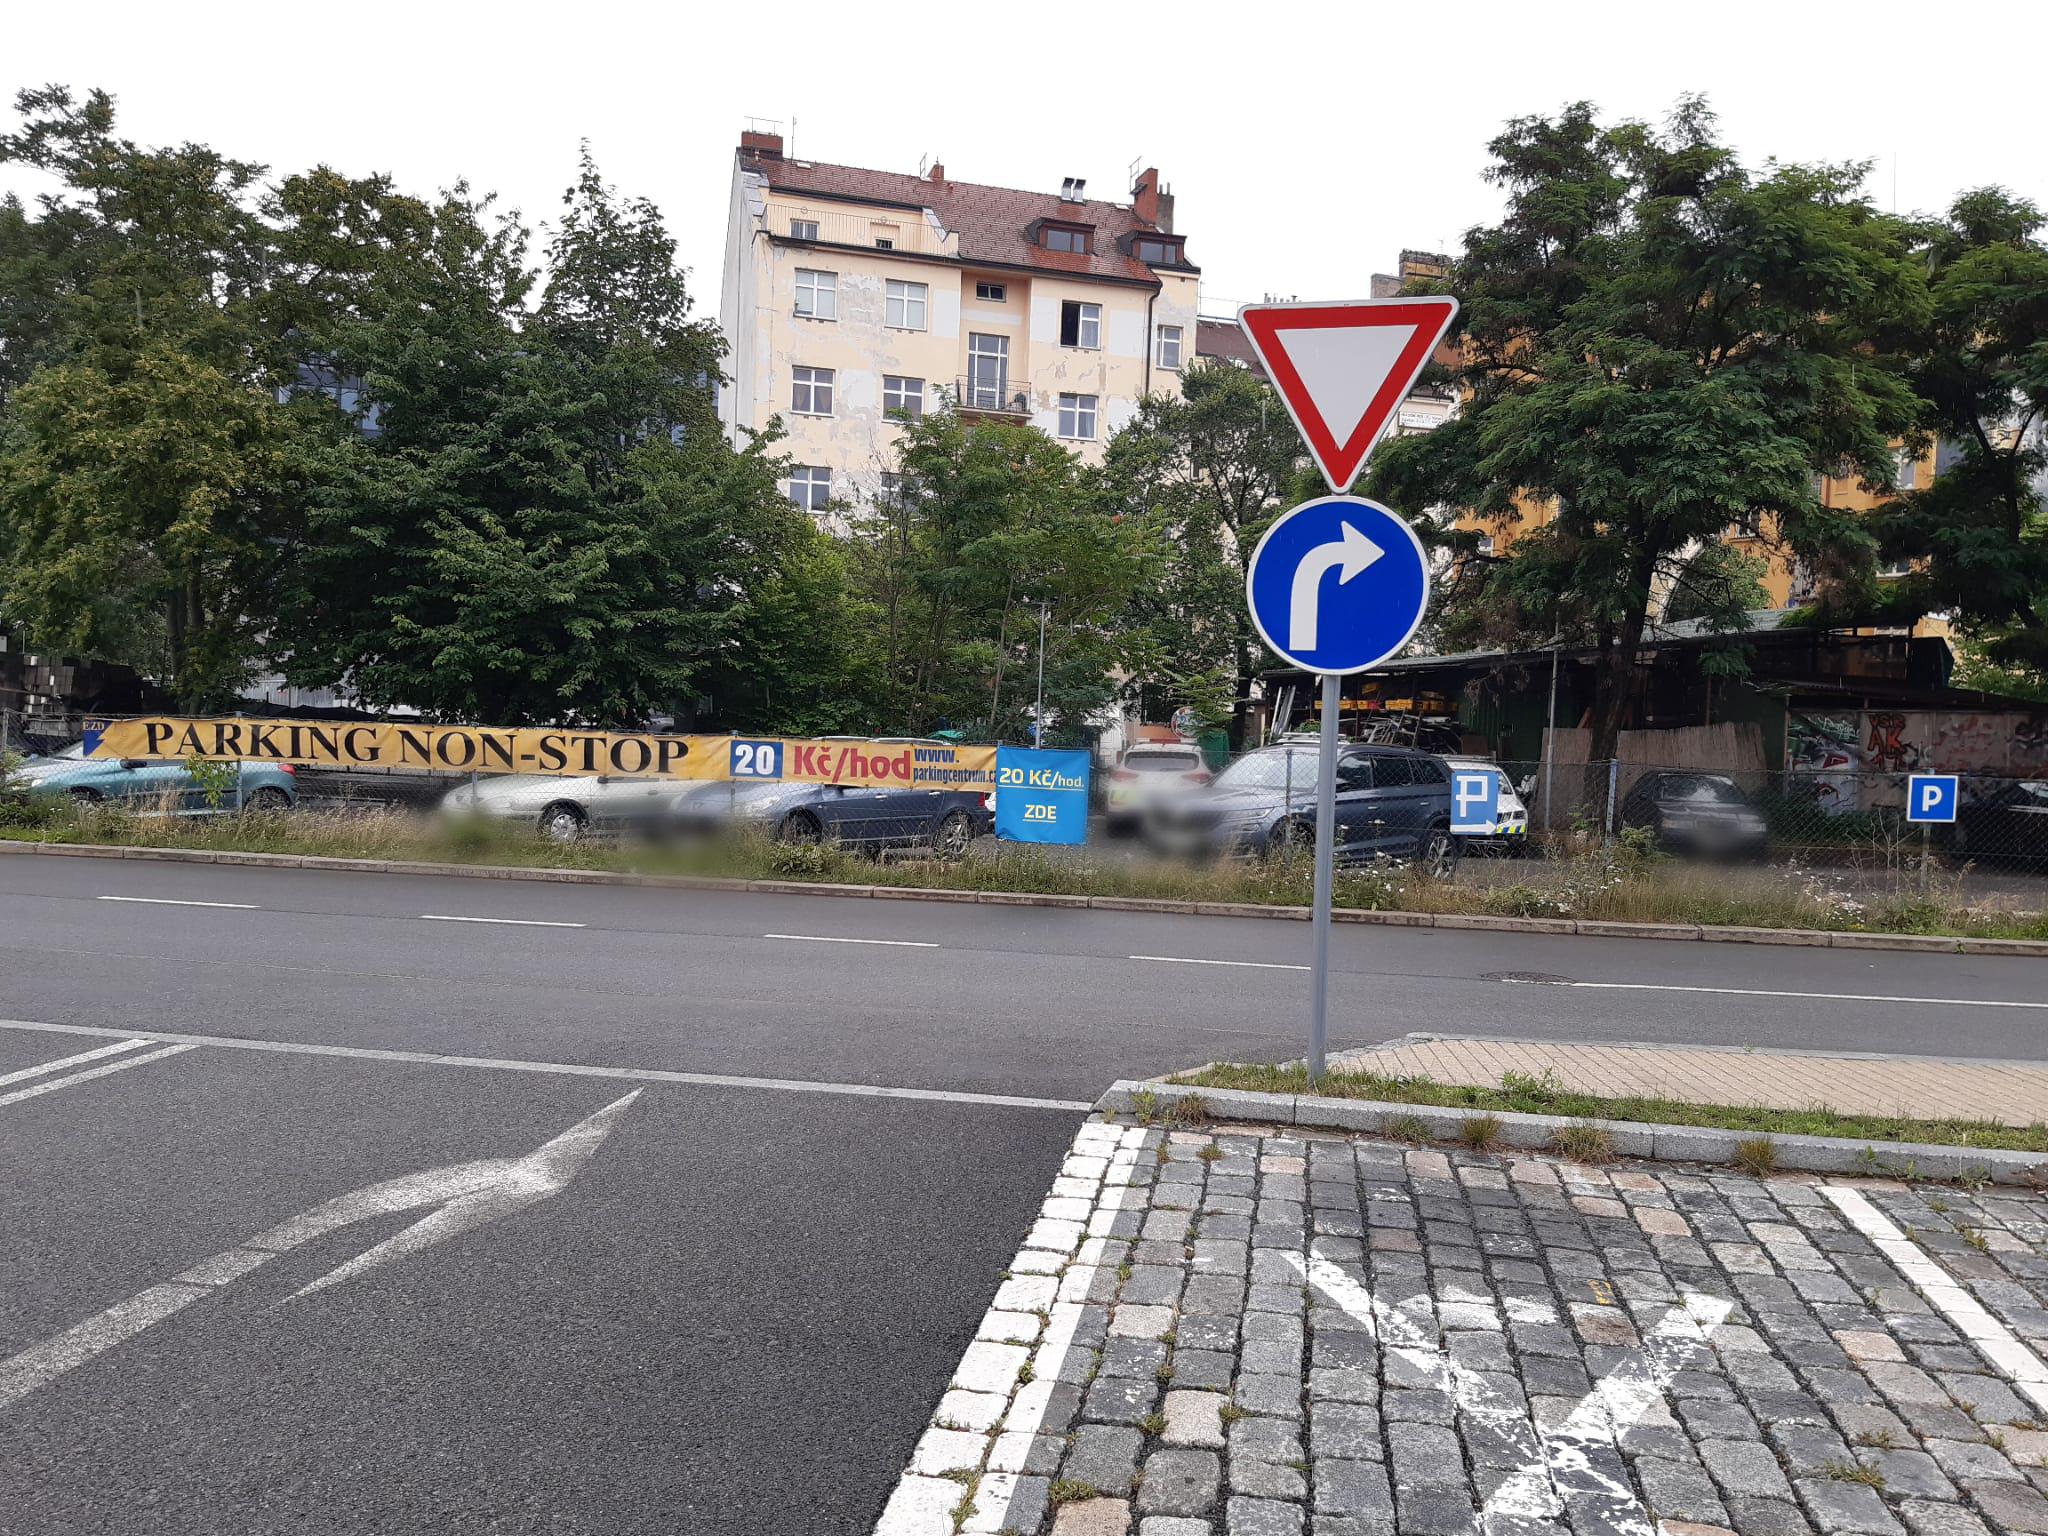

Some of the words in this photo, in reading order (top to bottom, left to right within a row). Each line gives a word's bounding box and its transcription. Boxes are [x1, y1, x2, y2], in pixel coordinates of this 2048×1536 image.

[144, 722, 382, 762] PARKING
[397, 729, 690, 774] NON-STOP
[734, 744, 776, 776] 20
[793, 745, 911, 784] Kč/hod
[914, 748, 960, 764] www.
[1000, 768, 1024, 784] 20
[1029, 769, 1085, 789] Kč/hod.
[1456, 775, 1488, 818] P
[1922, 785, 1943, 812] P
[1024, 804, 1057, 820] ZDE
